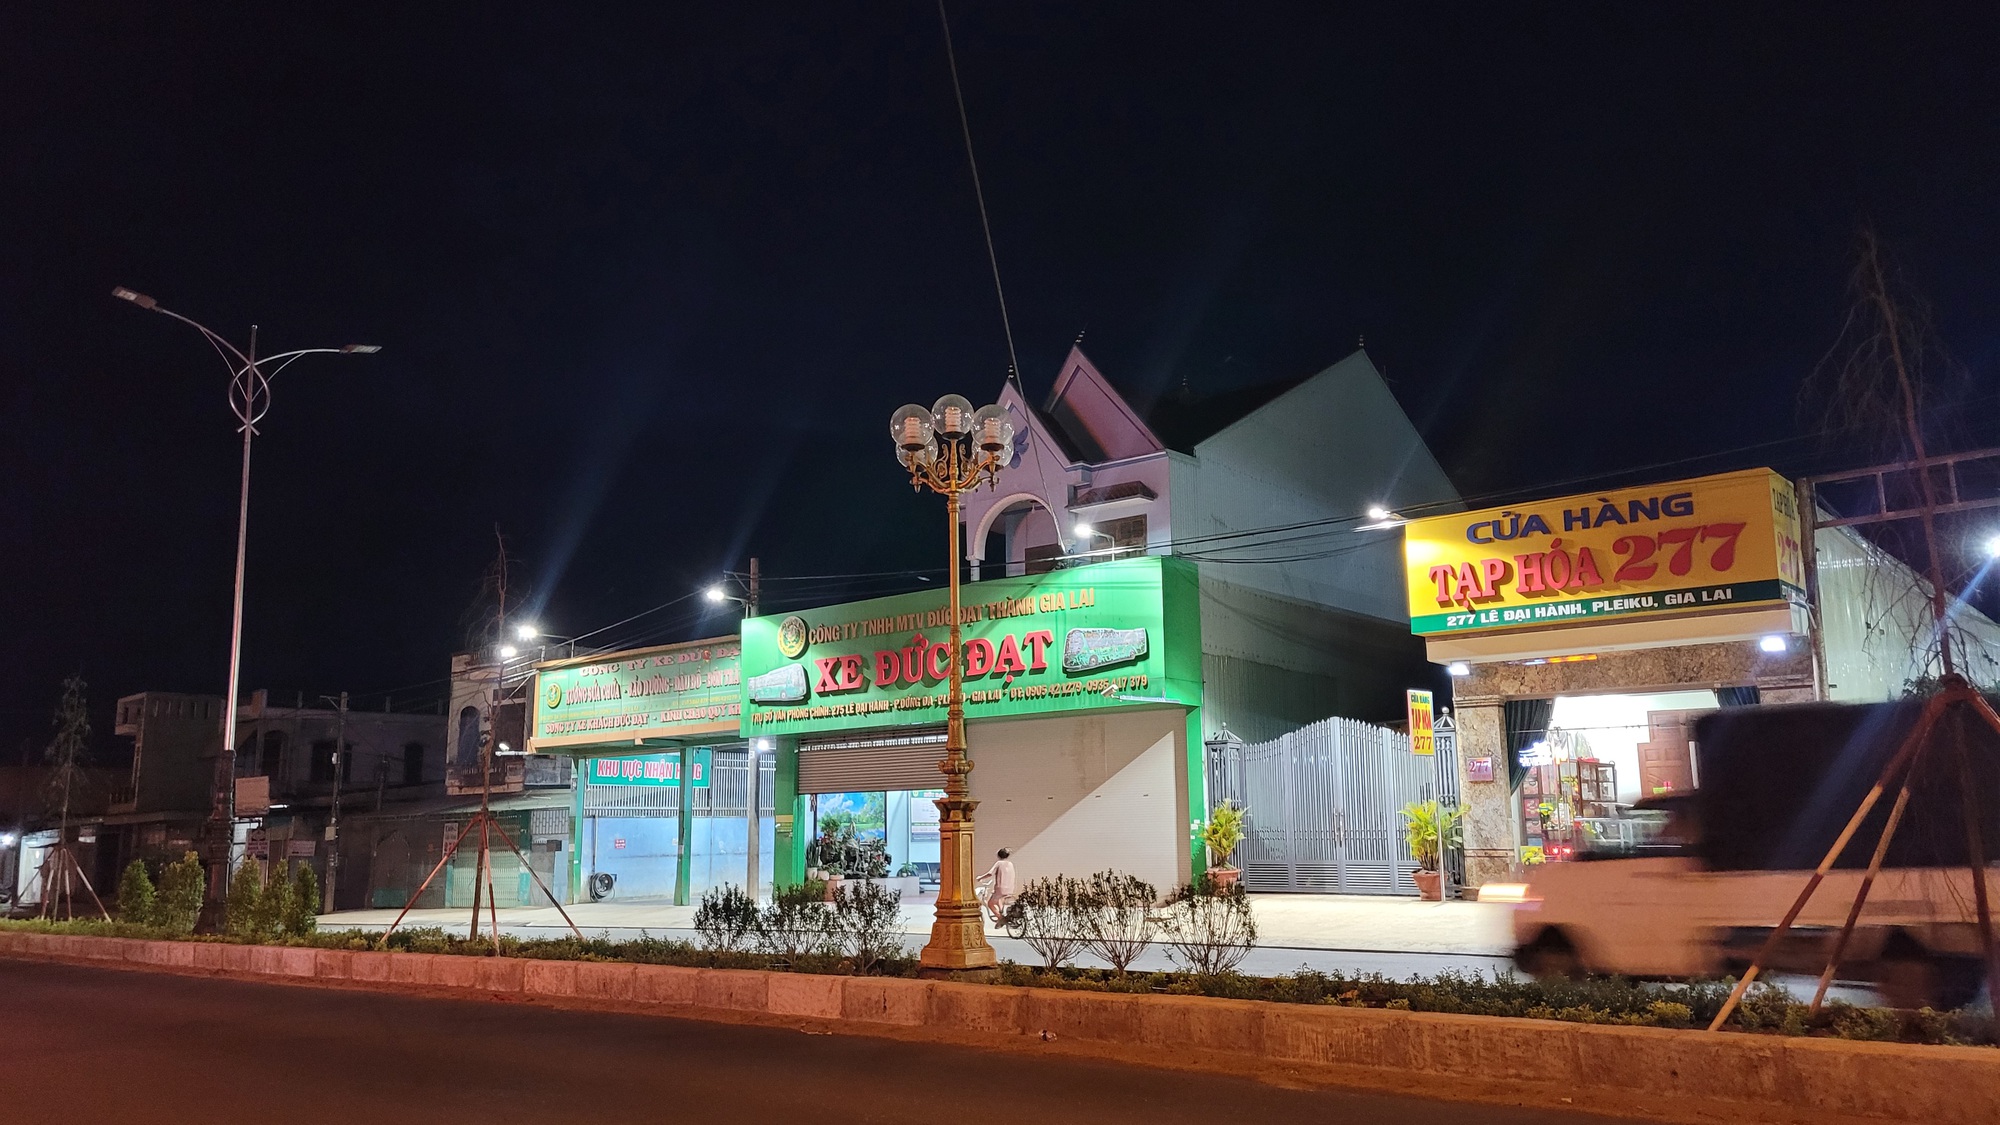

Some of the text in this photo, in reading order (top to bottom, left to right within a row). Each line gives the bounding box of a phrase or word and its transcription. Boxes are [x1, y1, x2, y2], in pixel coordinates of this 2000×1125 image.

[1466, 492, 1695, 544] CỬA HÀNG
[1429, 522, 1747, 609] TẠP HÓA 277
[808, 623, 841, 645] CÔNG
[844, 621, 860, 639] TY
[862, 616, 894, 636] TNHH
[897, 612, 925, 632] MTV
[927, 605, 952, 628] ĐỨC
[960, 604, 984, 627] ĐẠT
[987, 597, 1036, 620] THÀNH
[1039, 592, 1066, 613] GIA
[1069, 587, 1095, 609] LAI
[1446, 587, 1733, 628] 277 LÊ ĐẠI HÀNH, PLEIKU, GIA LAI
[579, 663, 620, 677] CÔNG
[627, 658, 648, 671] TY
[653, 655, 675, 667] XE
[677, 648, 712, 664] ĐỨ
[814, 629, 1054, 693] XE ĐỨC ĐẠT
[832, 705, 845, 716] 275
[972, 690, 986, 702] GIA
[988, 689, 1002, 701] LAI
[1025, 685, 1047, 697] 0905
[1130, 675, 1147, 687] 379
[1414, 736, 1432, 750] 277
[597, 758, 620, 778] KHU
[622, 759, 643, 782] VỰC
[644, 759, 673, 783] NHẬN
[1469, 760, 1489, 773] 277
